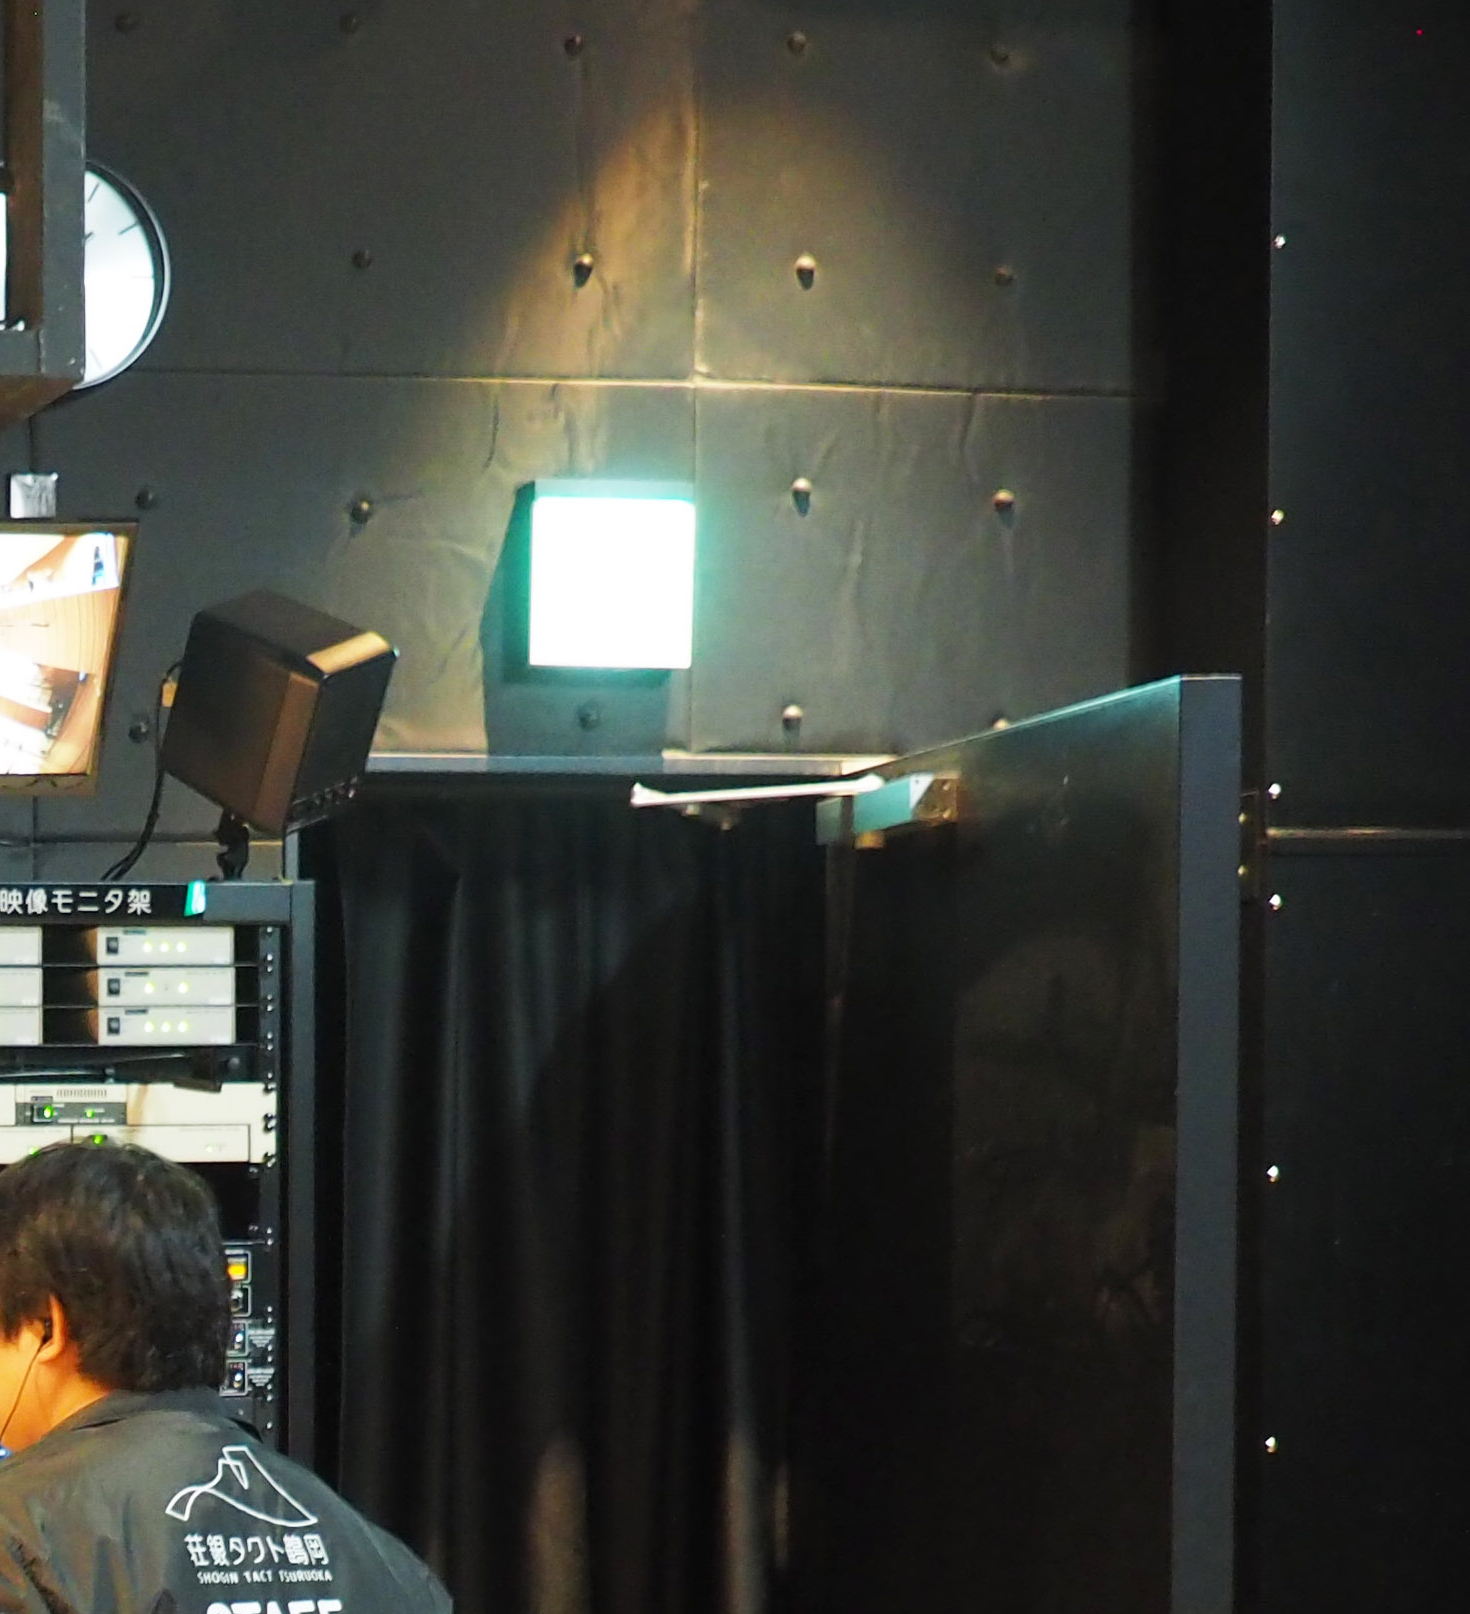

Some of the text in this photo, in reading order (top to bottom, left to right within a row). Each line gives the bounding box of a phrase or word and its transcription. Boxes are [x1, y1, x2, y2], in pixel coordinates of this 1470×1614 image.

[0, 888, 152, 915] 映像モニタ架
[183, 1532, 330, 1568] 荘銀タクト鶴岡
[196, 1568, 334, 1585] SHOGIN TACT TSURUOKA
